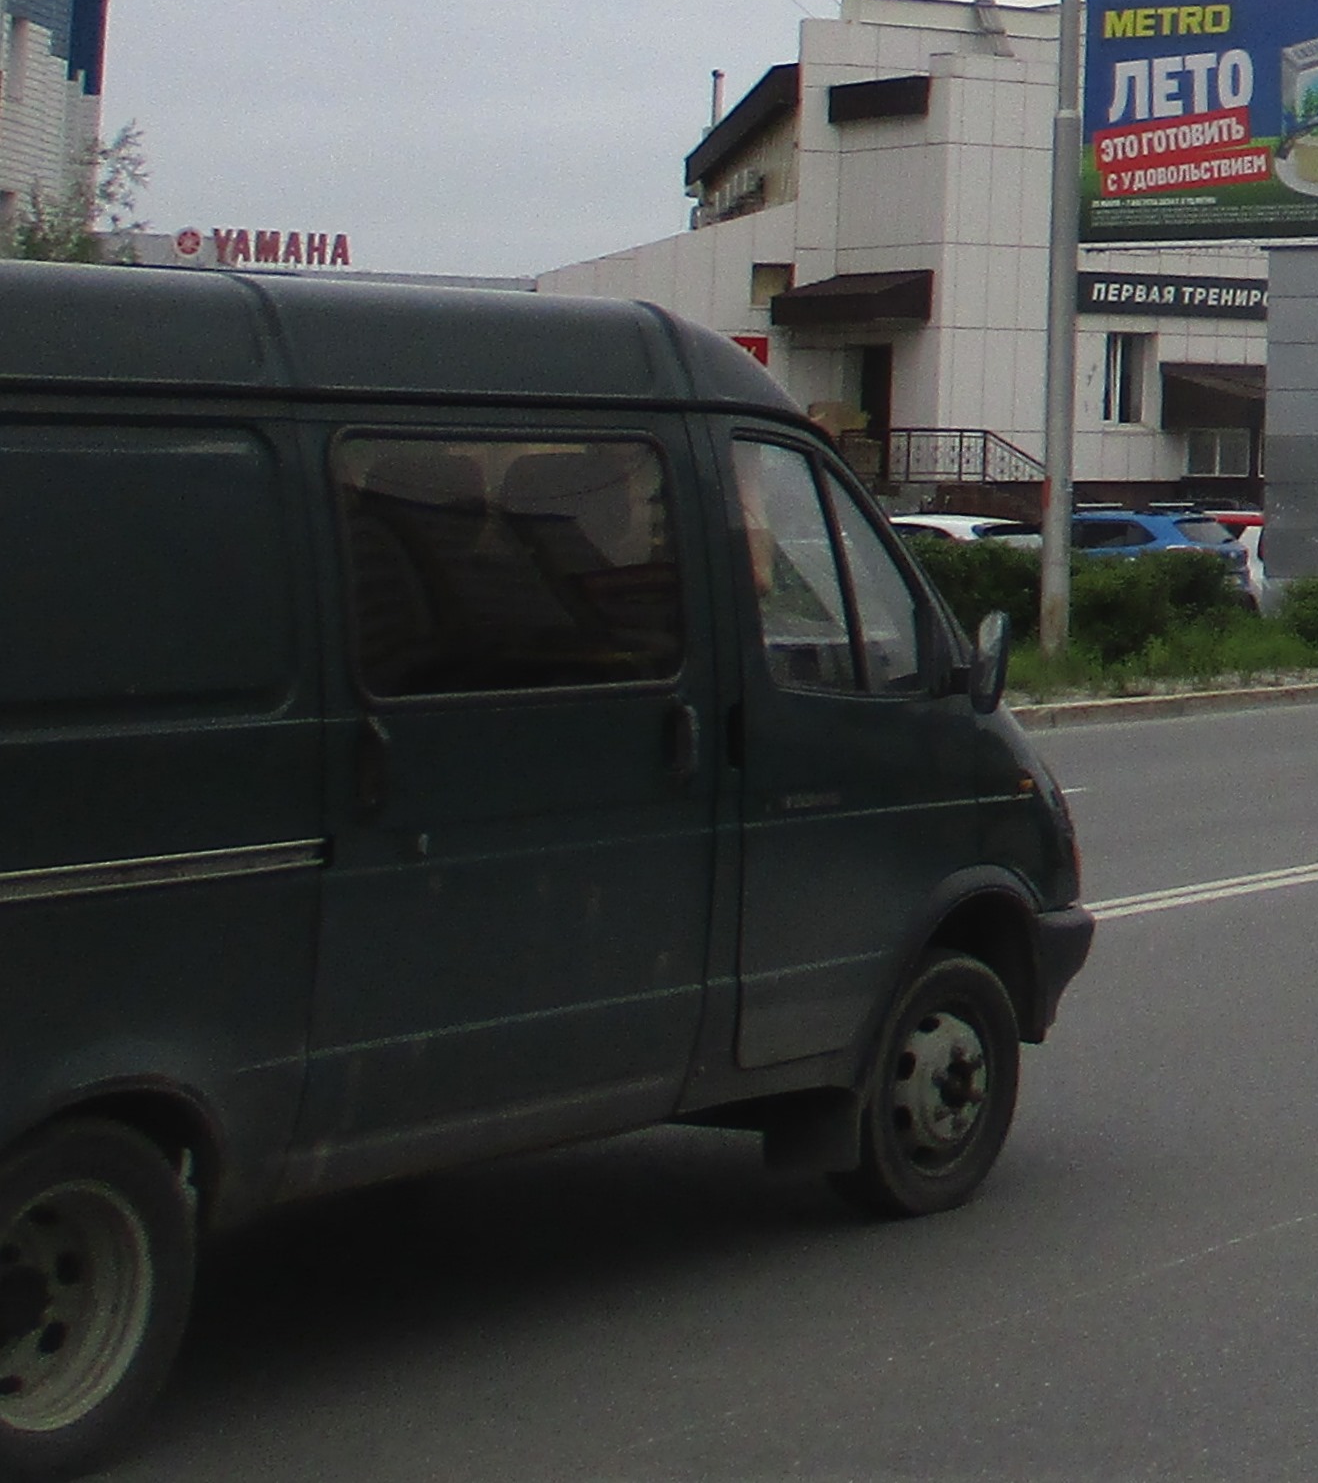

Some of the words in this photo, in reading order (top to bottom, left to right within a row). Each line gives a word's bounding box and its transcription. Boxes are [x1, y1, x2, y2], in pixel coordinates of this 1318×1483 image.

[1104, 4, 1231, 38] METRO
[1109, 49, 1253, 123] ЛЕТО
[1101, 135, 1138, 163] ЭТО
[1141, 117, 1245, 156] ГОТОВИТЬ
[1121, 154, 1267, 192] УДОВОЛЬСТВИЕМ
[213, 228, 349, 265] YAMAHA
[1092, 282, 1175, 305] ПЕРВАЯ
